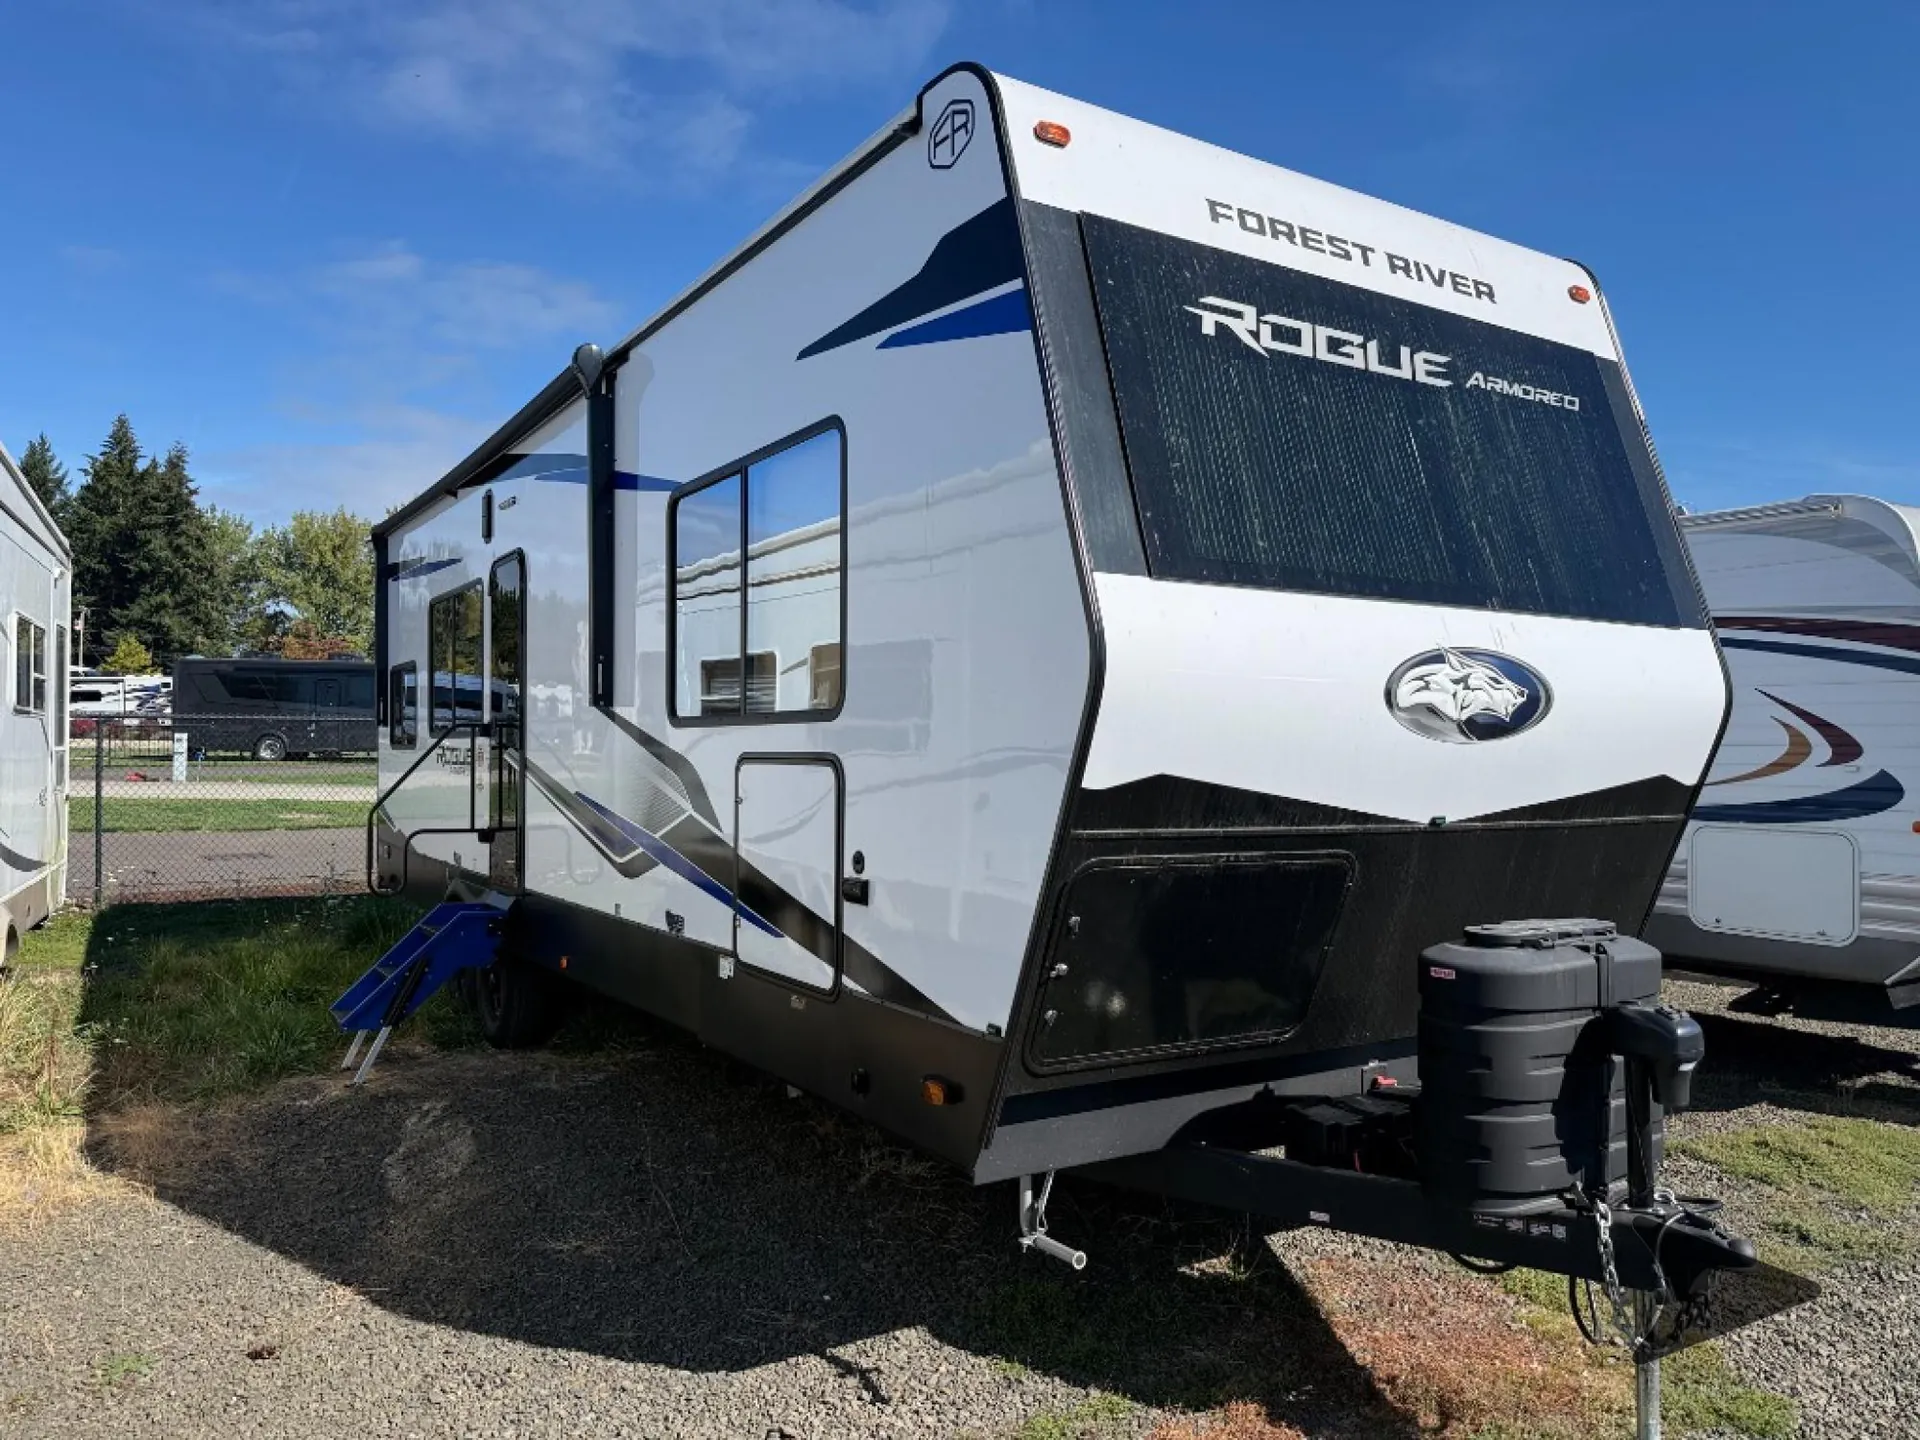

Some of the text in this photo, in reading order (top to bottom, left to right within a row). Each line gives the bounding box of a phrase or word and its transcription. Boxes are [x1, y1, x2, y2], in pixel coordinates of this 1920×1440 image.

[1205, 198, 1497, 304] FOREST RIVER
[1183, 296, 1580, 411] ROGUE ARMORED
